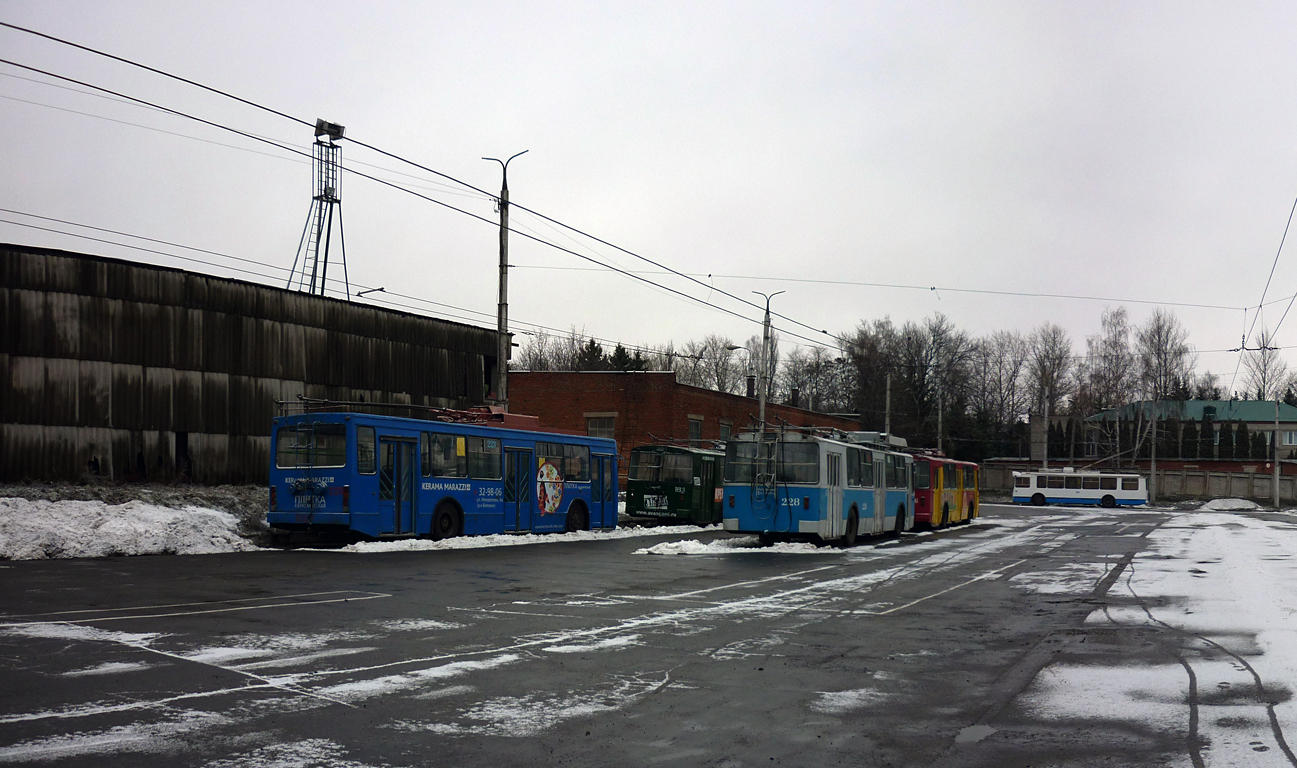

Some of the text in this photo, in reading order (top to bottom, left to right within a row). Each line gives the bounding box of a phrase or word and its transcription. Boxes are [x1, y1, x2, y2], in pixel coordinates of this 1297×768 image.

[422, 482, 466, 491] KERAMA MARAZZI
[479, 487, 503, 496] 32-98-06
[781, 497, 800, 507] 228
